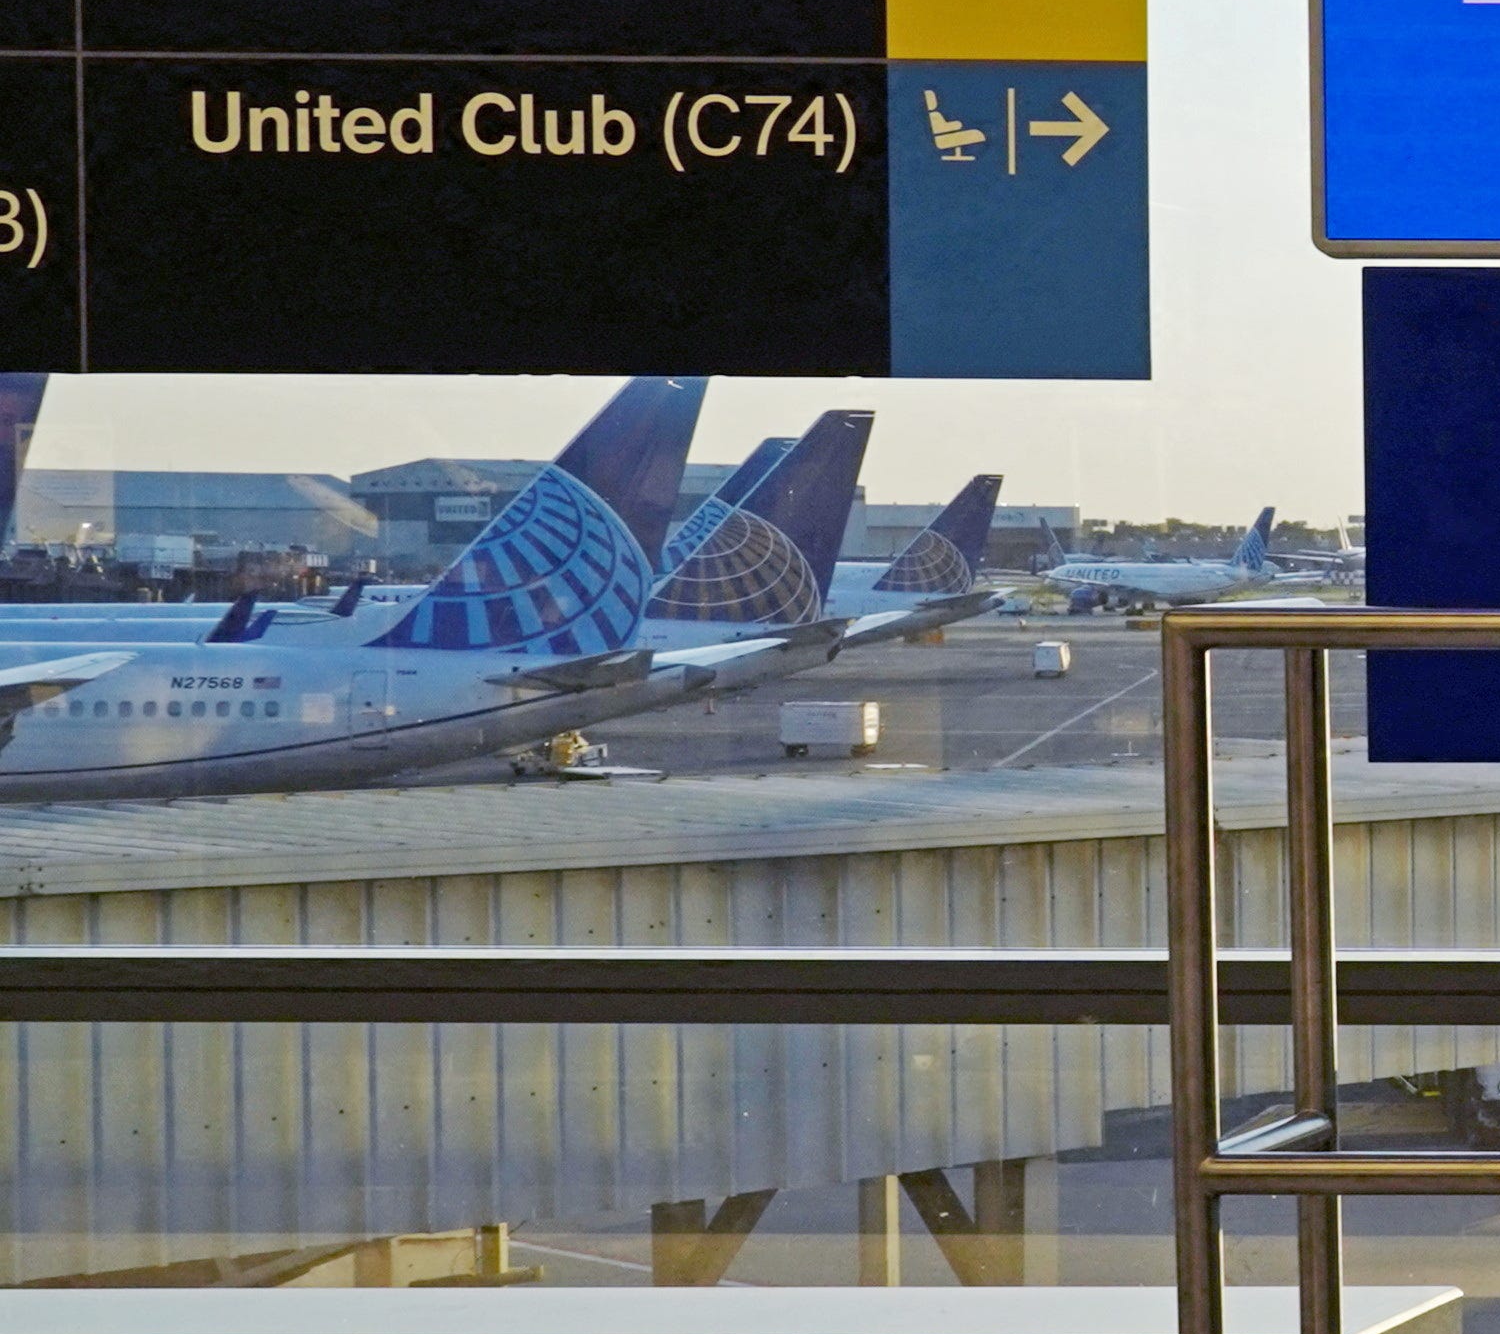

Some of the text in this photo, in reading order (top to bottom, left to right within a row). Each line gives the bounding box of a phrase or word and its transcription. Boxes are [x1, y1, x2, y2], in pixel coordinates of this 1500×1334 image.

[191, 89, 857, 174] United Club (C74)
[1065, 568, 1120, 581] UNITED
[170, 675, 245, 690] N27568
